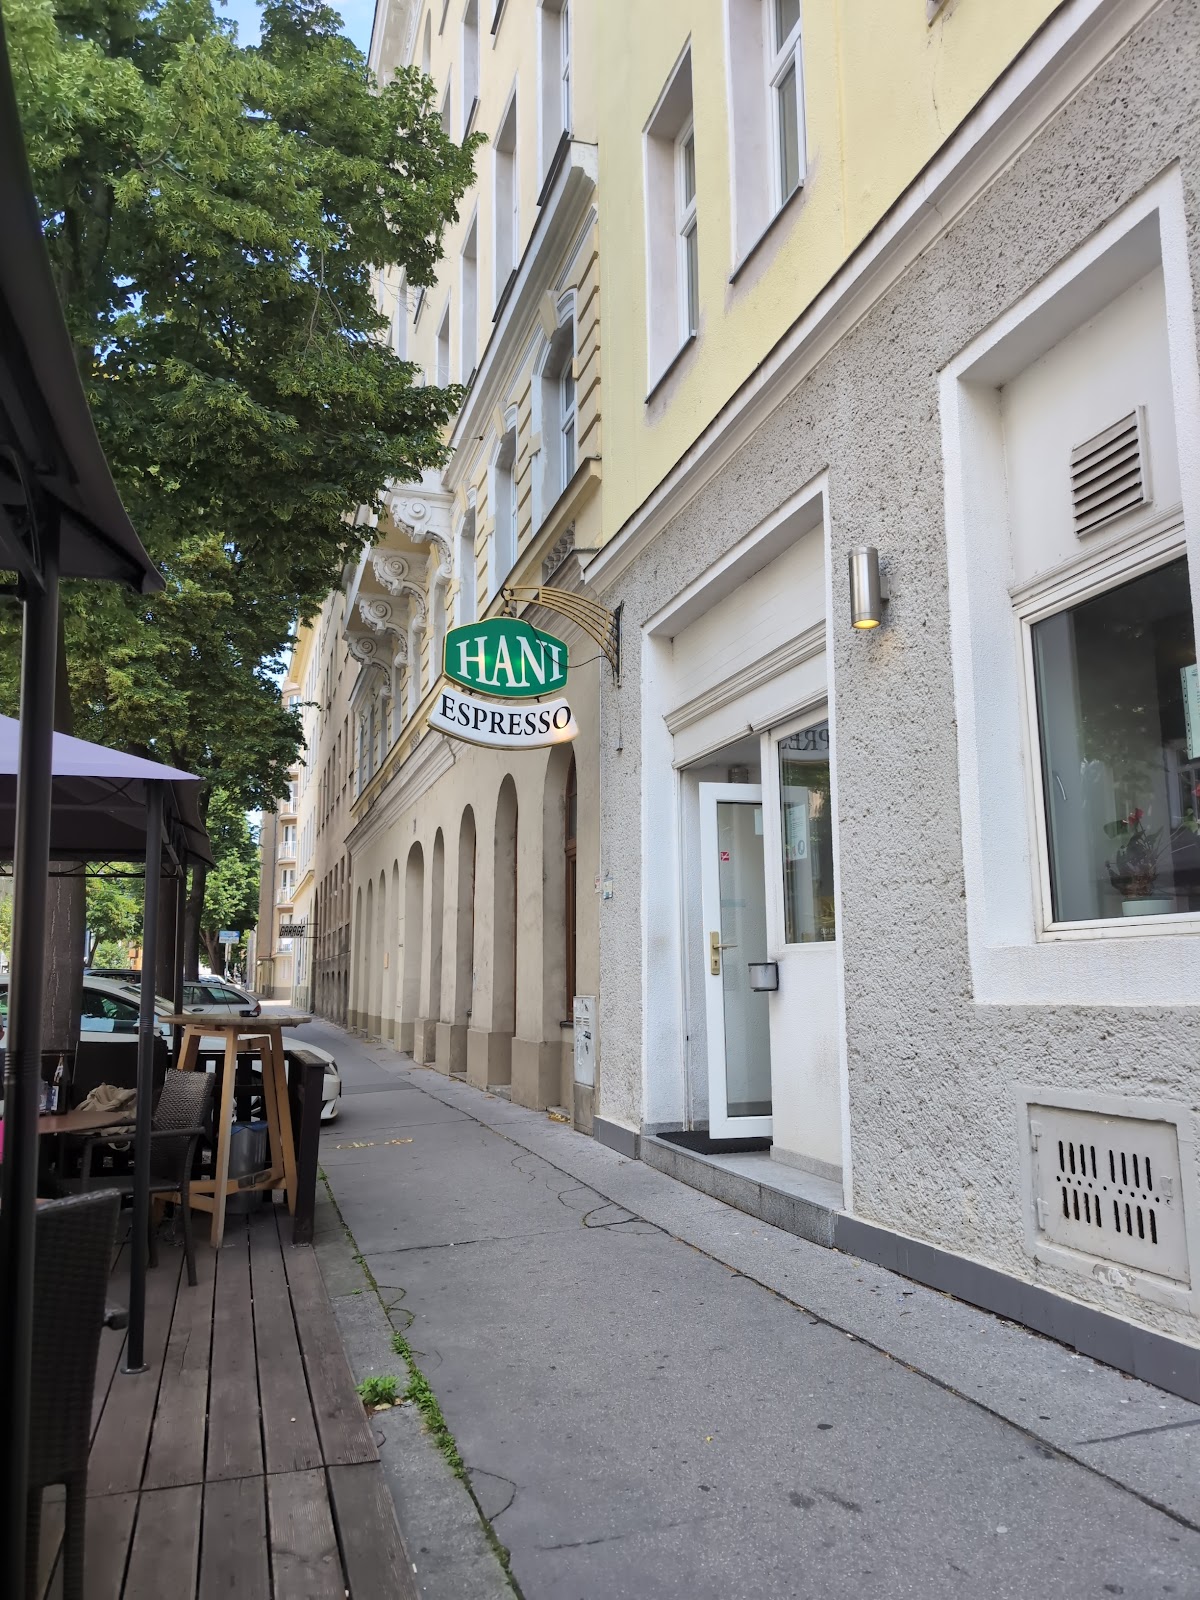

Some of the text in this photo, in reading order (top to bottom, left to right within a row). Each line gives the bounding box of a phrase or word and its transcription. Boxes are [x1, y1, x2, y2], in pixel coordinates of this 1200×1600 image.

[456, 635, 563, 687] HANI
[439, 694, 571, 735] ESPRESSO
[280, 925, 305, 937] GARAGE
